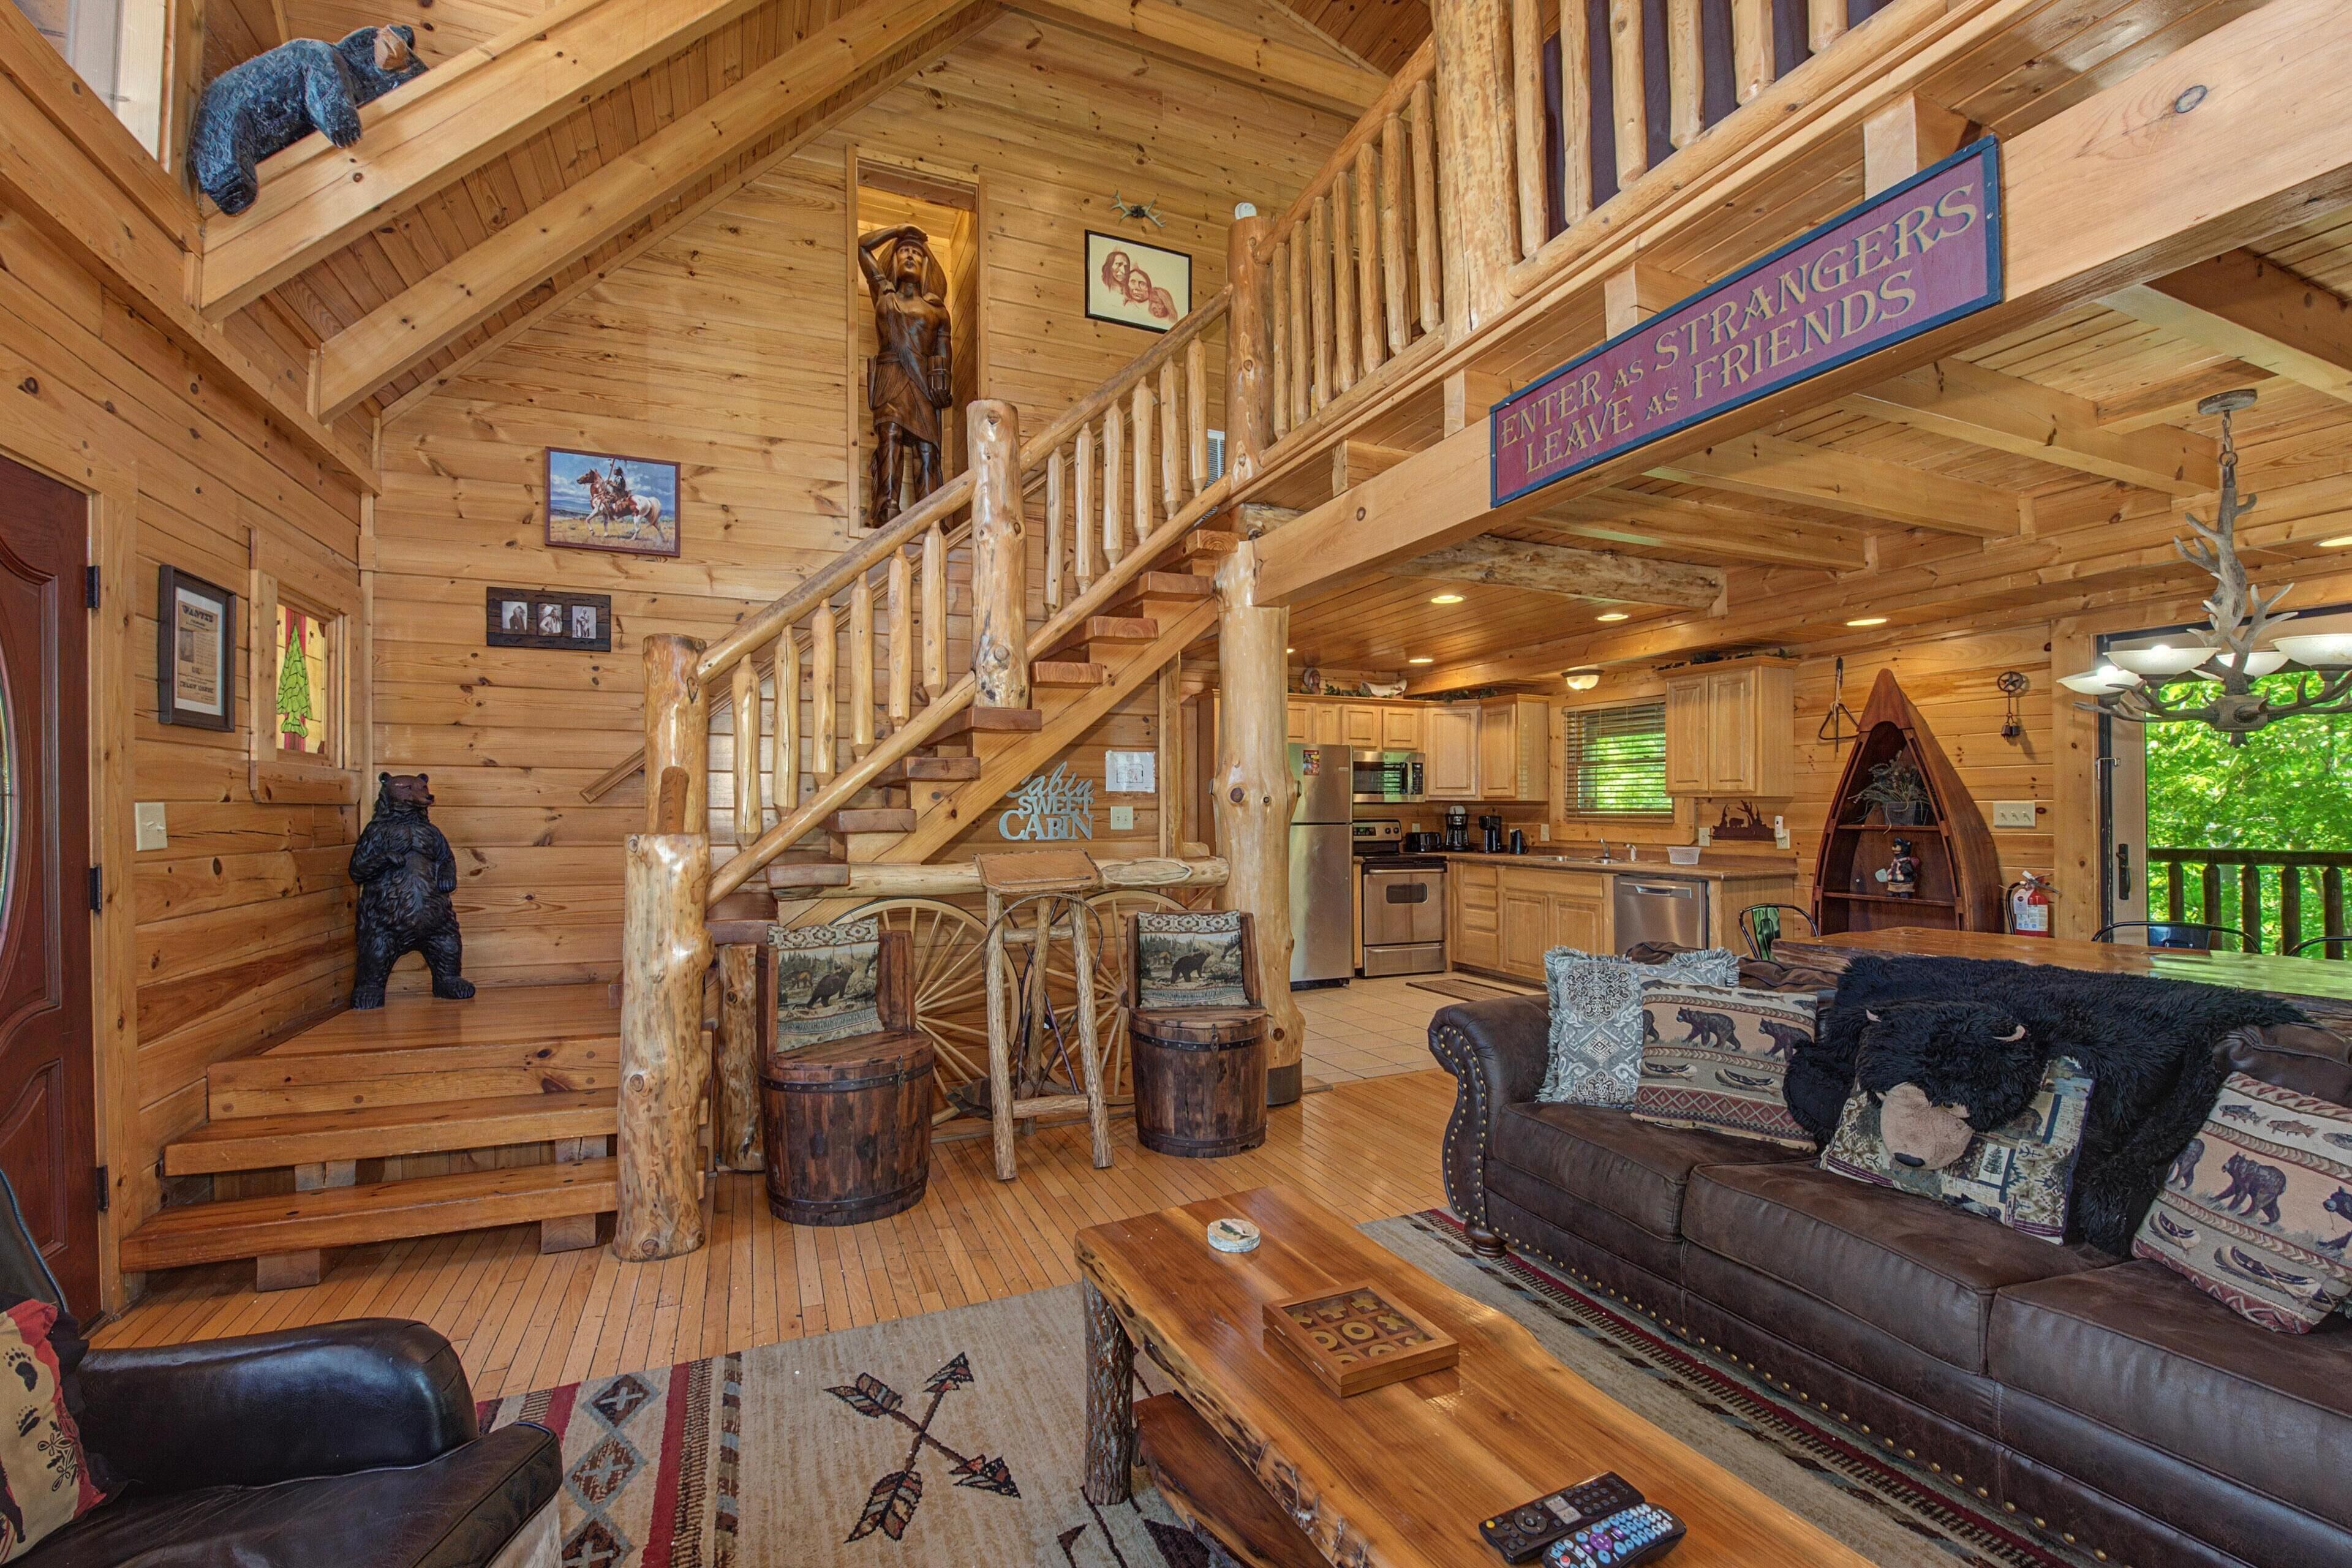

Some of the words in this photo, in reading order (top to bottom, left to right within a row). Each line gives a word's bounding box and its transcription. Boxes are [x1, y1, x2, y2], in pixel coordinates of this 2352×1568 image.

[1500, 371, 1604, 450] ENTER
[1654, 183, 1979, 371] STRANGERS
[1524, 396, 1634, 474] LEAVE
[1692, 268, 1918, 400] FRIENDS
[998, 809, 1095, 840] CABIN
[1018, 796, 1094, 815] SWEET
